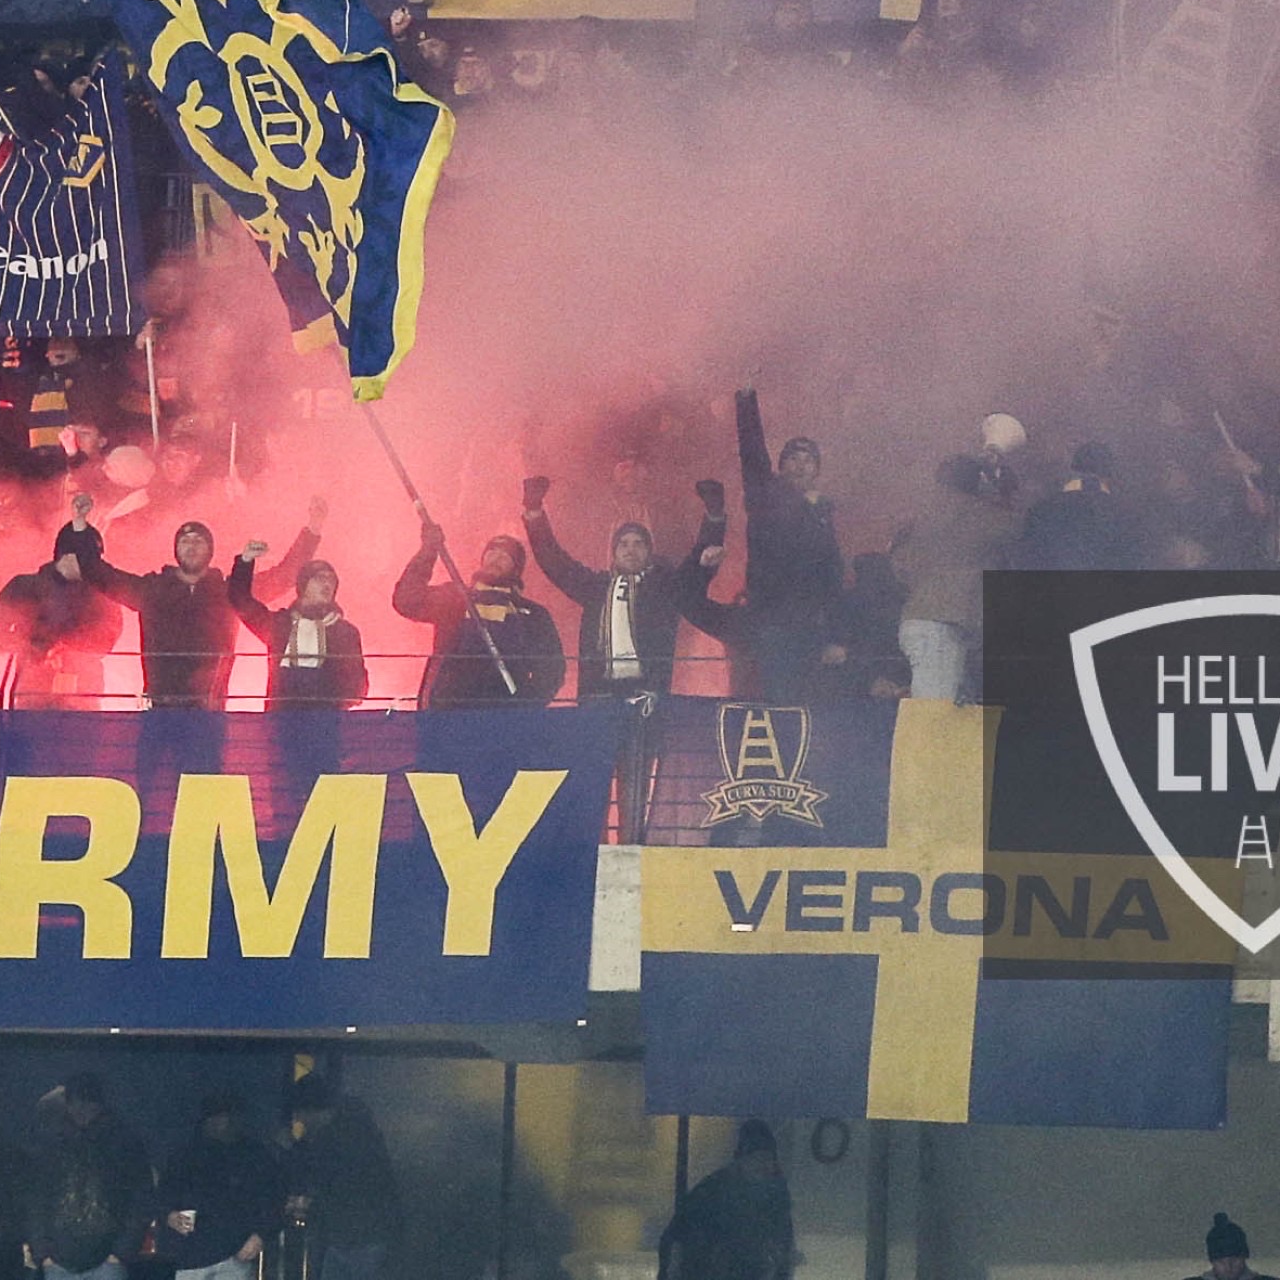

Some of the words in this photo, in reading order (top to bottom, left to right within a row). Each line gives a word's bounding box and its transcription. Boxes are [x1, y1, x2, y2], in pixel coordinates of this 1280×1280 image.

[727, 785, 766, 801] CURVA
[770, 785, 797, 800] SUD
[714, 869, 1170, 942] VERONA
